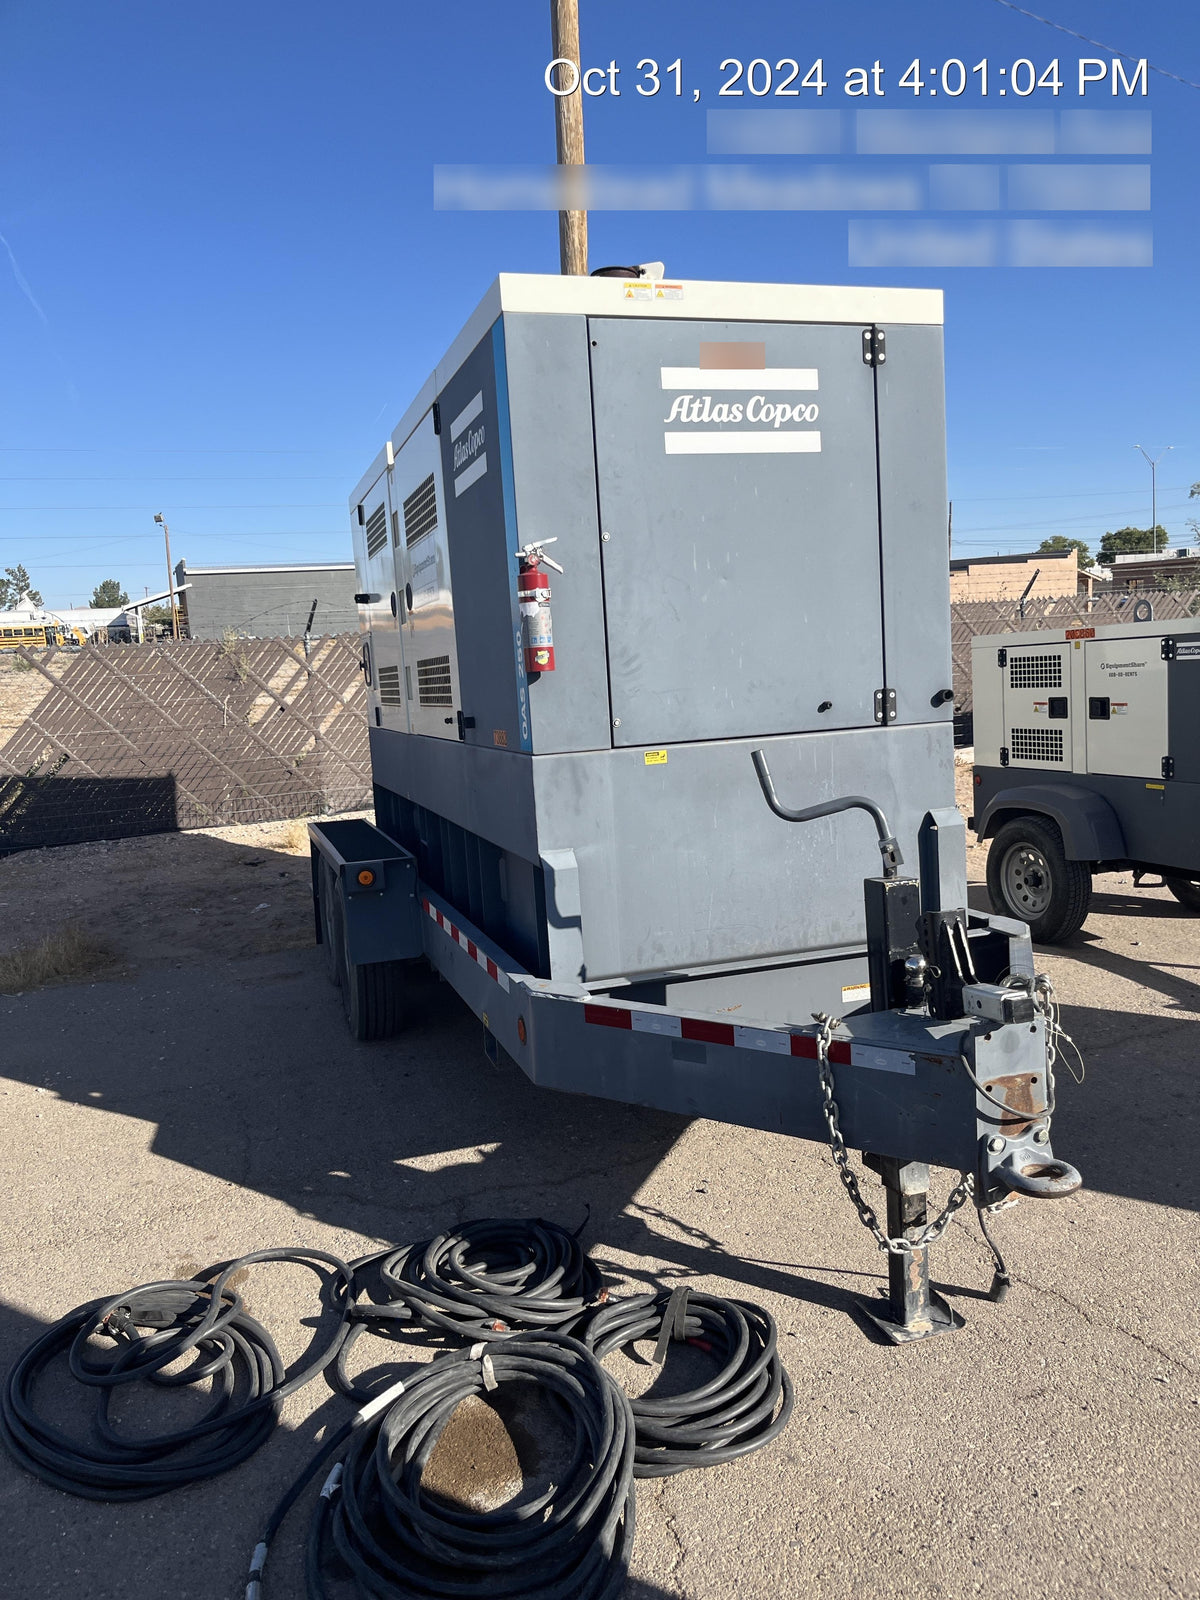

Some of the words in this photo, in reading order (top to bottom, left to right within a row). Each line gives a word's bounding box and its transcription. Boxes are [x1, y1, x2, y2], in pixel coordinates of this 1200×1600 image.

[663, 394, 744, 423] Atlas
[746, 395, 820, 429] Copco
[516, 630, 525, 678] 250
